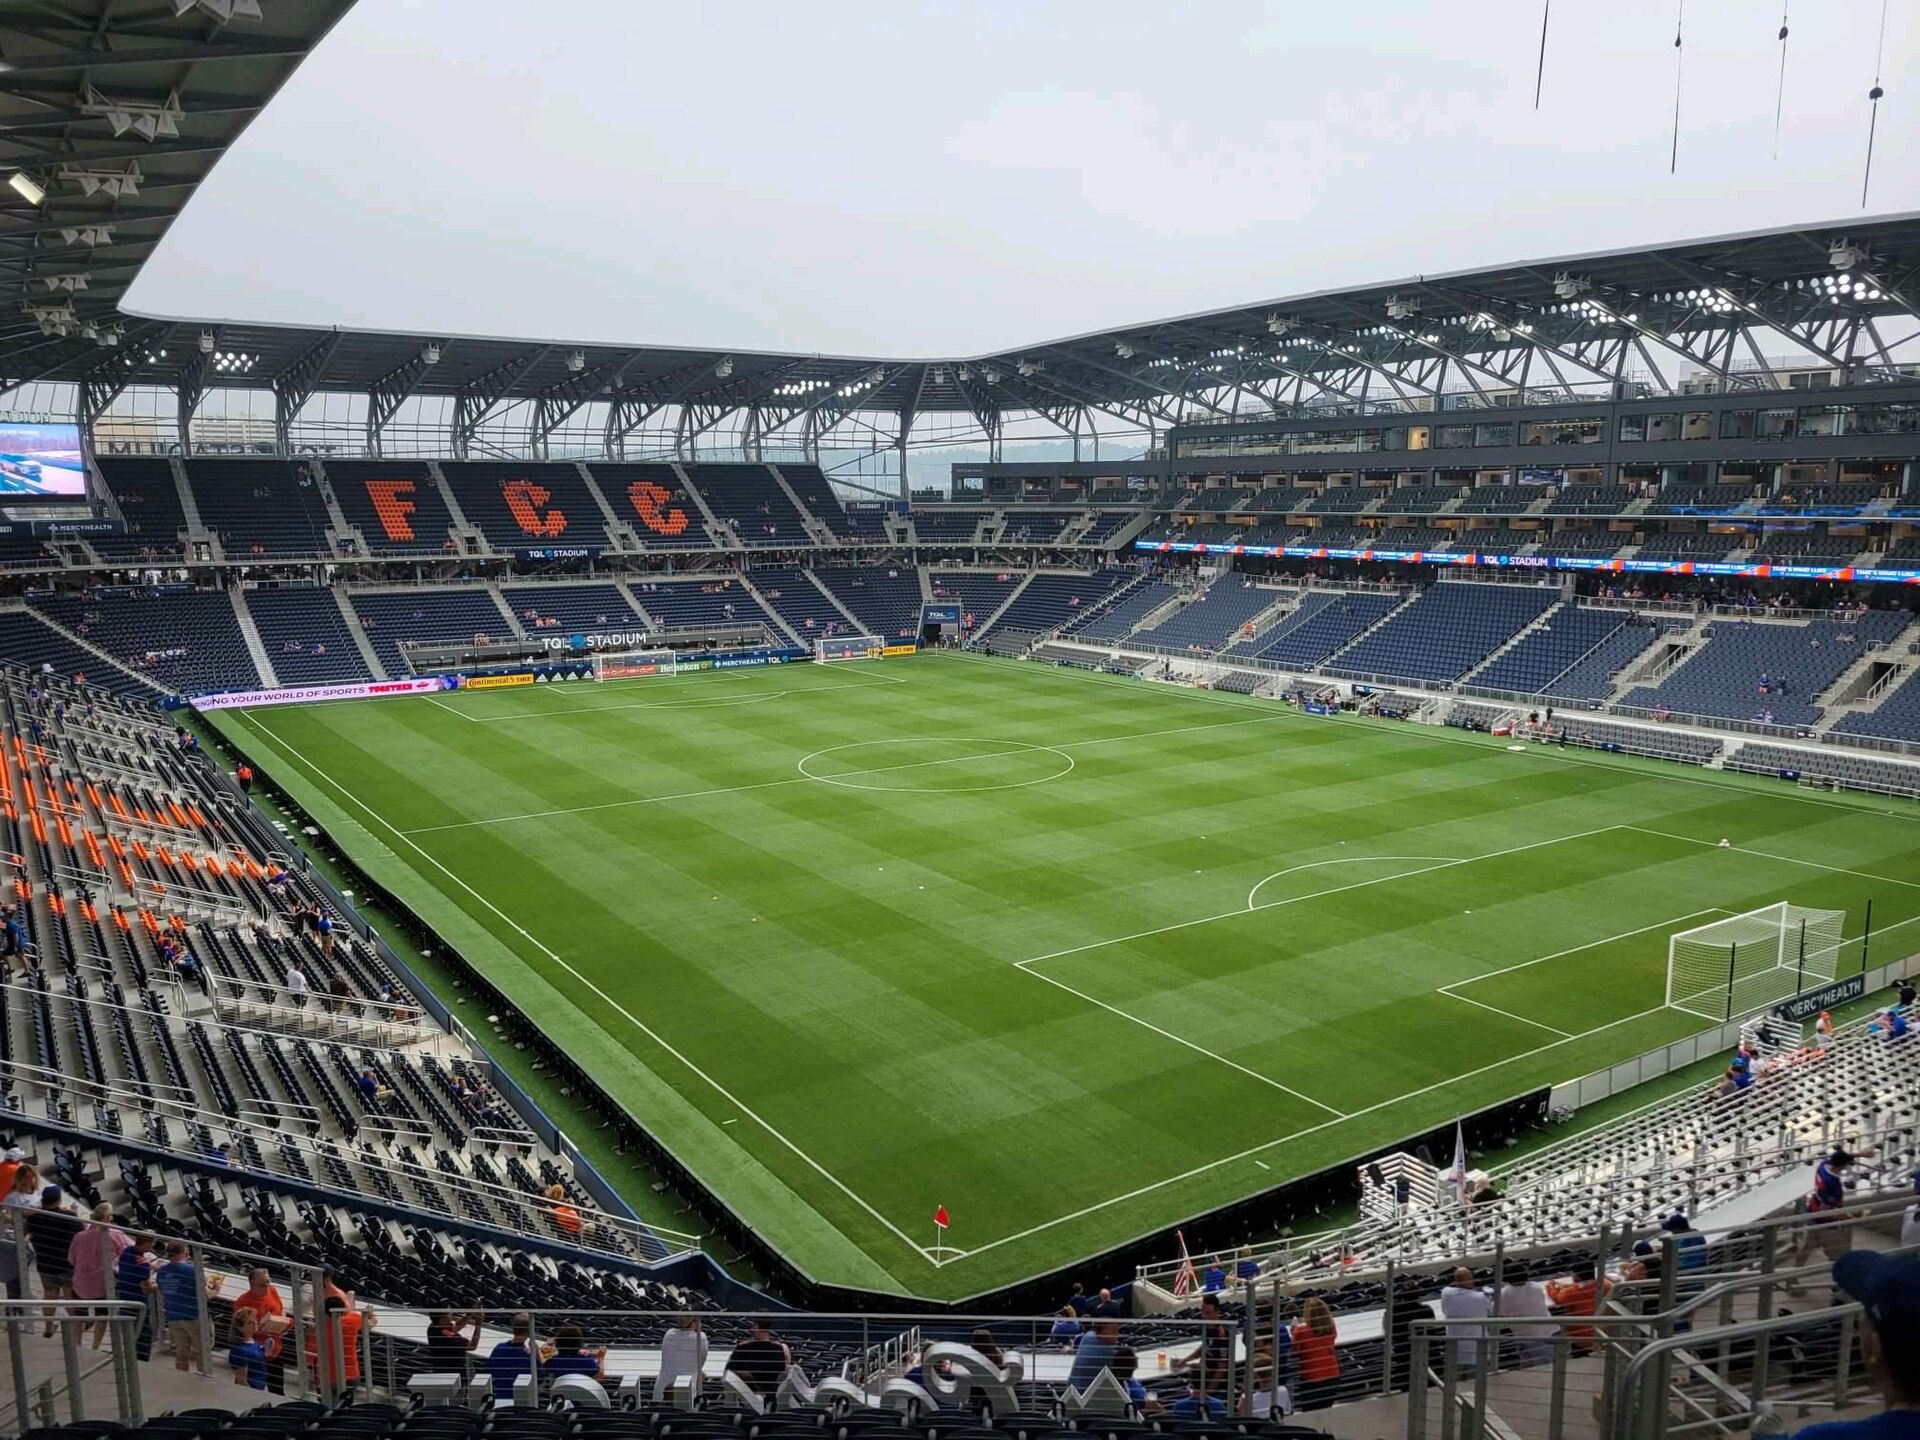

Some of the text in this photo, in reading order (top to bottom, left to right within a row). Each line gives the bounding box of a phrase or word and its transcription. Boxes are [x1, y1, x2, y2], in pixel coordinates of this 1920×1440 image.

[528, 549, 588, 558] TQL STADIUM
[1483, 555, 1548, 567] TQL STADIUM
[541, 632, 647, 650] TQL STADIUM
[660, 662, 700, 673] Heineken
[722, 658, 765, 667] MERCYHEALTH
[231, 694, 262, 703] YOUR
[264, 691, 304, 701] WORLD
[306, 688, 320, 697] OF
[322, 686, 366, 697] SPORTS
